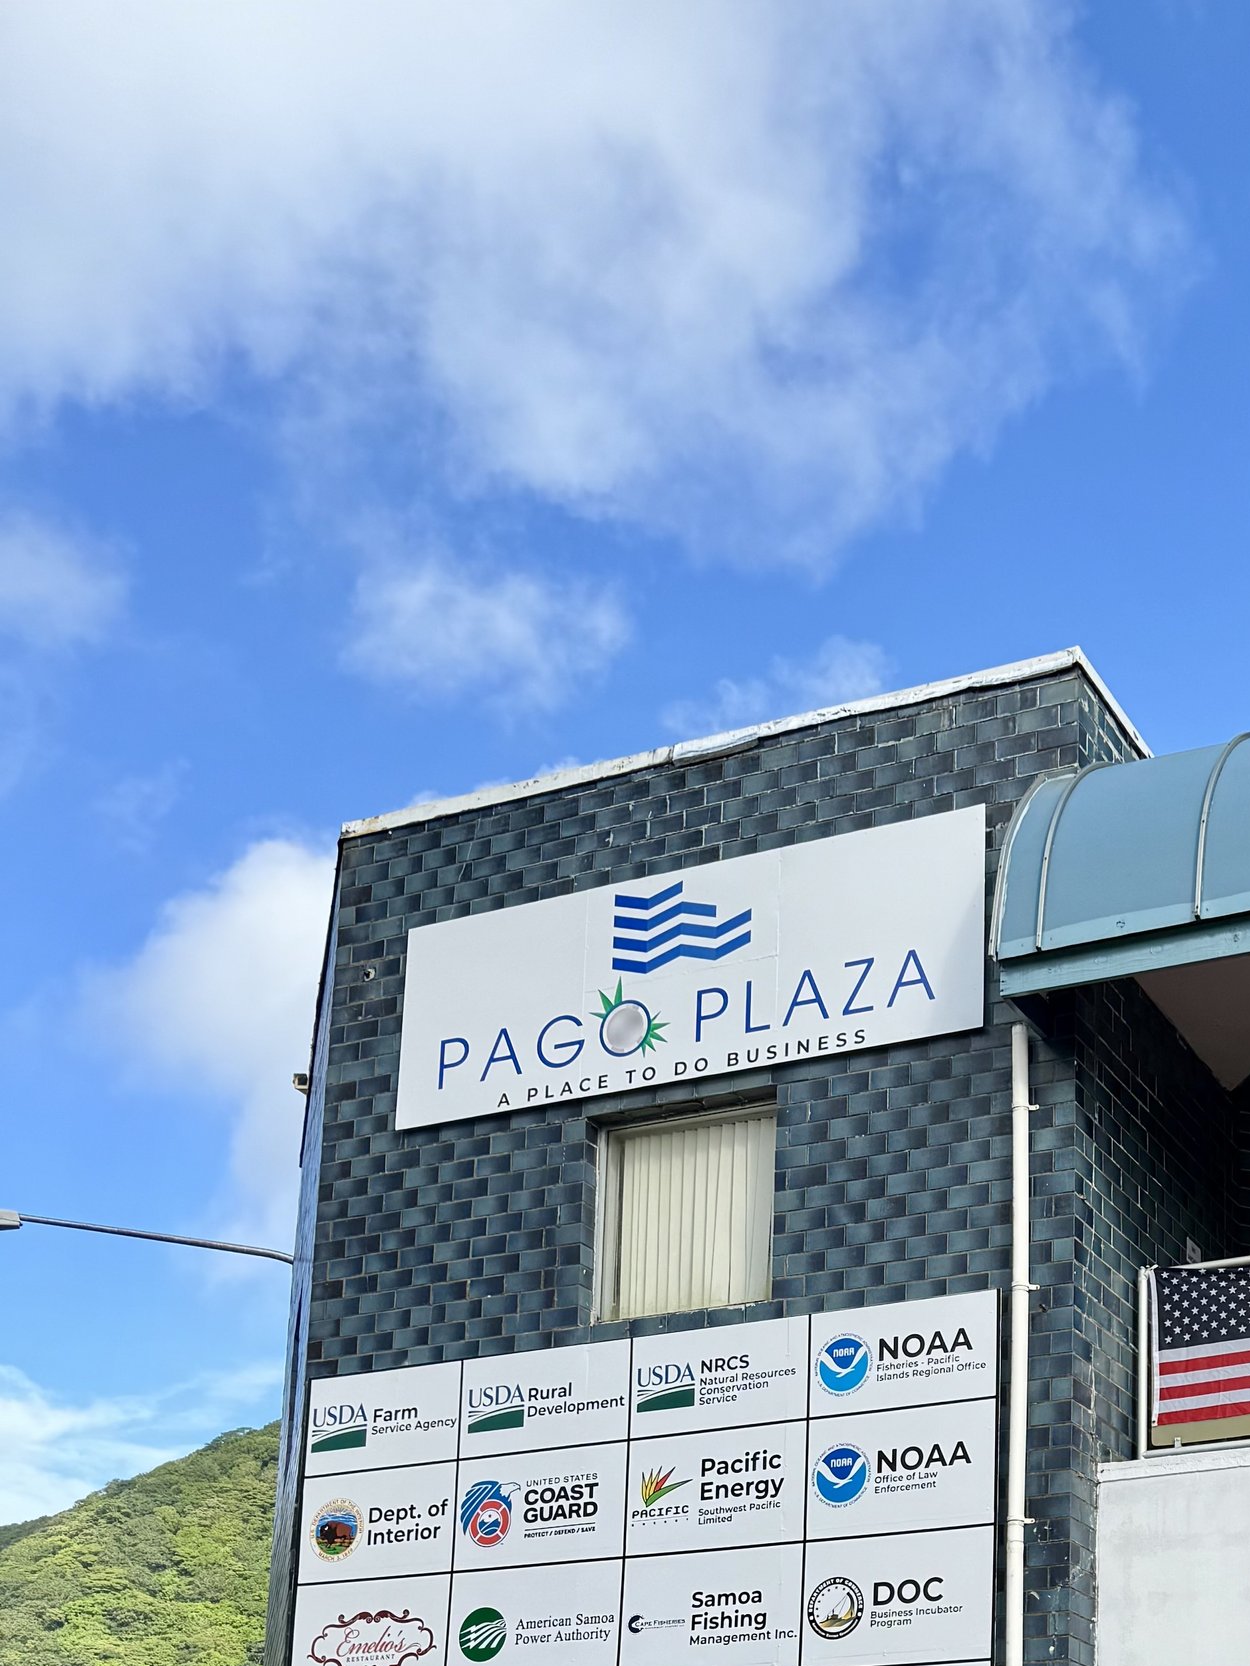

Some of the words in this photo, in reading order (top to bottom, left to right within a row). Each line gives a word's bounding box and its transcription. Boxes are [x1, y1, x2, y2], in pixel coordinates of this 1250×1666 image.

[438, 999, 652, 1091] PAGO
[695, 948, 936, 1043] PLAZA
[497, 1092, 511, 1108] A
[526, 1074, 609, 1102] PLACE
[625, 1067, 656, 1084] TO
[674, 1057, 709, 1077] DO
[727, 1029, 867, 1066] BUSINESS
[833, 1347, 855, 1358] NOAA
[878, 1327, 973, 1362] NOAA
[700, 1355, 750, 1374] NRCS
[876, 1370, 909, 1382] Islands
[913, 1365, 954, 1380] Regional
[956, 1361, 986, 1372] Office
[877, 1360, 919, 1372] Fisheries
[927, 1353, 960, 1366] Pacific
[637, 1362, 695, 1387] USDA
[700, 1372, 738, 1386] Natural
[741, 1366, 796, 1381] Resources
[468, 1384, 525, 1409] USDA
[528, 1382, 572, 1402] Rural
[700, 1379, 769, 1396] Conservation
[527, 1395, 625, 1418] Development
[699, 1393, 737, 1406] Service
[313, 1403, 367, 1428] USDA
[372, 1405, 418, 1423] Farm
[371, 1422, 412, 1436] Service
[414, 1417, 457, 1432] Agency
[700, 1450, 782, 1478] Pacific
[830, 1457, 853, 1469] NOAA
[876, 1441, 972, 1473] NOAA
[527, 1477, 560, 1487] UNITED
[563, 1473, 598, 1483] STATES
[874, 1472, 902, 1485] Office
[904, 1471, 914, 1481] of
[918, 1470, 938, 1480] Law
[874, 1480, 937, 1495] Enforcement
[524, 1483, 599, 1505] COAST
[700, 1476, 785, 1502] Energy
[368, 1503, 422, 1525] Dept.
[428, 1499, 449, 1517] of
[523, 1501, 598, 1523] GUARD
[632, 1505, 689, 1519] PACIFIC
[698, 1514, 733, 1525] Limited
[699, 1505, 747, 1519] Southwest
[749, 1500, 781, 1512] Pacific
[367, 1523, 441, 1546] Interior
[691, 1589, 762, 1609] Samoa
[873, 1576, 945, 1606] DOC
[515, 1614, 572, 1631] American
[575, 1612, 615, 1626] Samoa
[691, 1609, 767, 1631] Fishing
[870, 1607, 913, 1619] Business
[915, 1604, 963, 1615] Incubator
[870, 1616, 912, 1628] Program
[336, 1626, 415, 1658] Emelio's
[515, 1631, 550, 1646] Power
[552, 1627, 611, 1644] Authority
[689, 1629, 771, 1646] Management
[775, 1628, 797, 1640] Inc.
[346, 1653, 396, 1663] RESTAURANT
